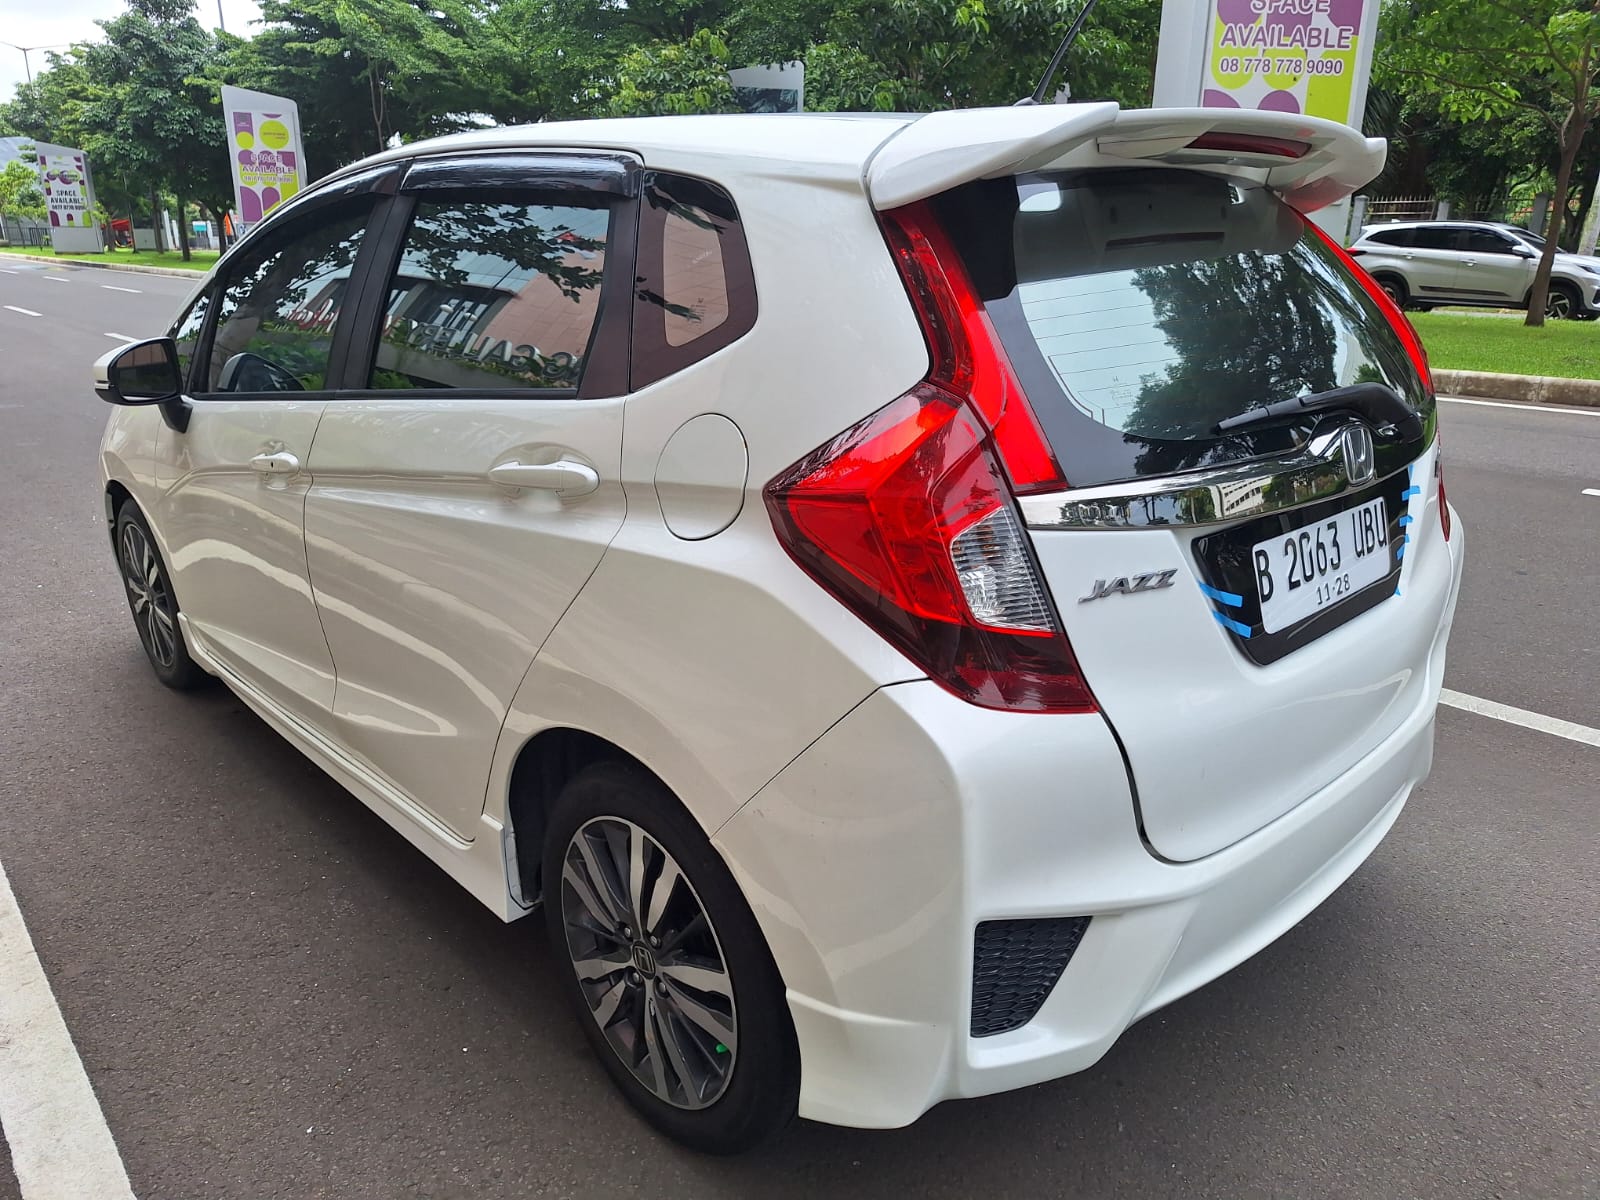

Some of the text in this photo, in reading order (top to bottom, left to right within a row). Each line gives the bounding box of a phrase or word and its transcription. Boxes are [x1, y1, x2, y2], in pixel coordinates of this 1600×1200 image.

[1220, 25, 1353, 49] AVAILABLE
[1220, 58, 1343, 75] 08 778 778 9090
[250, 152, 282, 163] SPACE
[242, 165, 294, 175] AVAILABLE
[1254, 501, 1387, 604] B 2063 UBU
[1078, 568, 1178, 605] JAZZ
